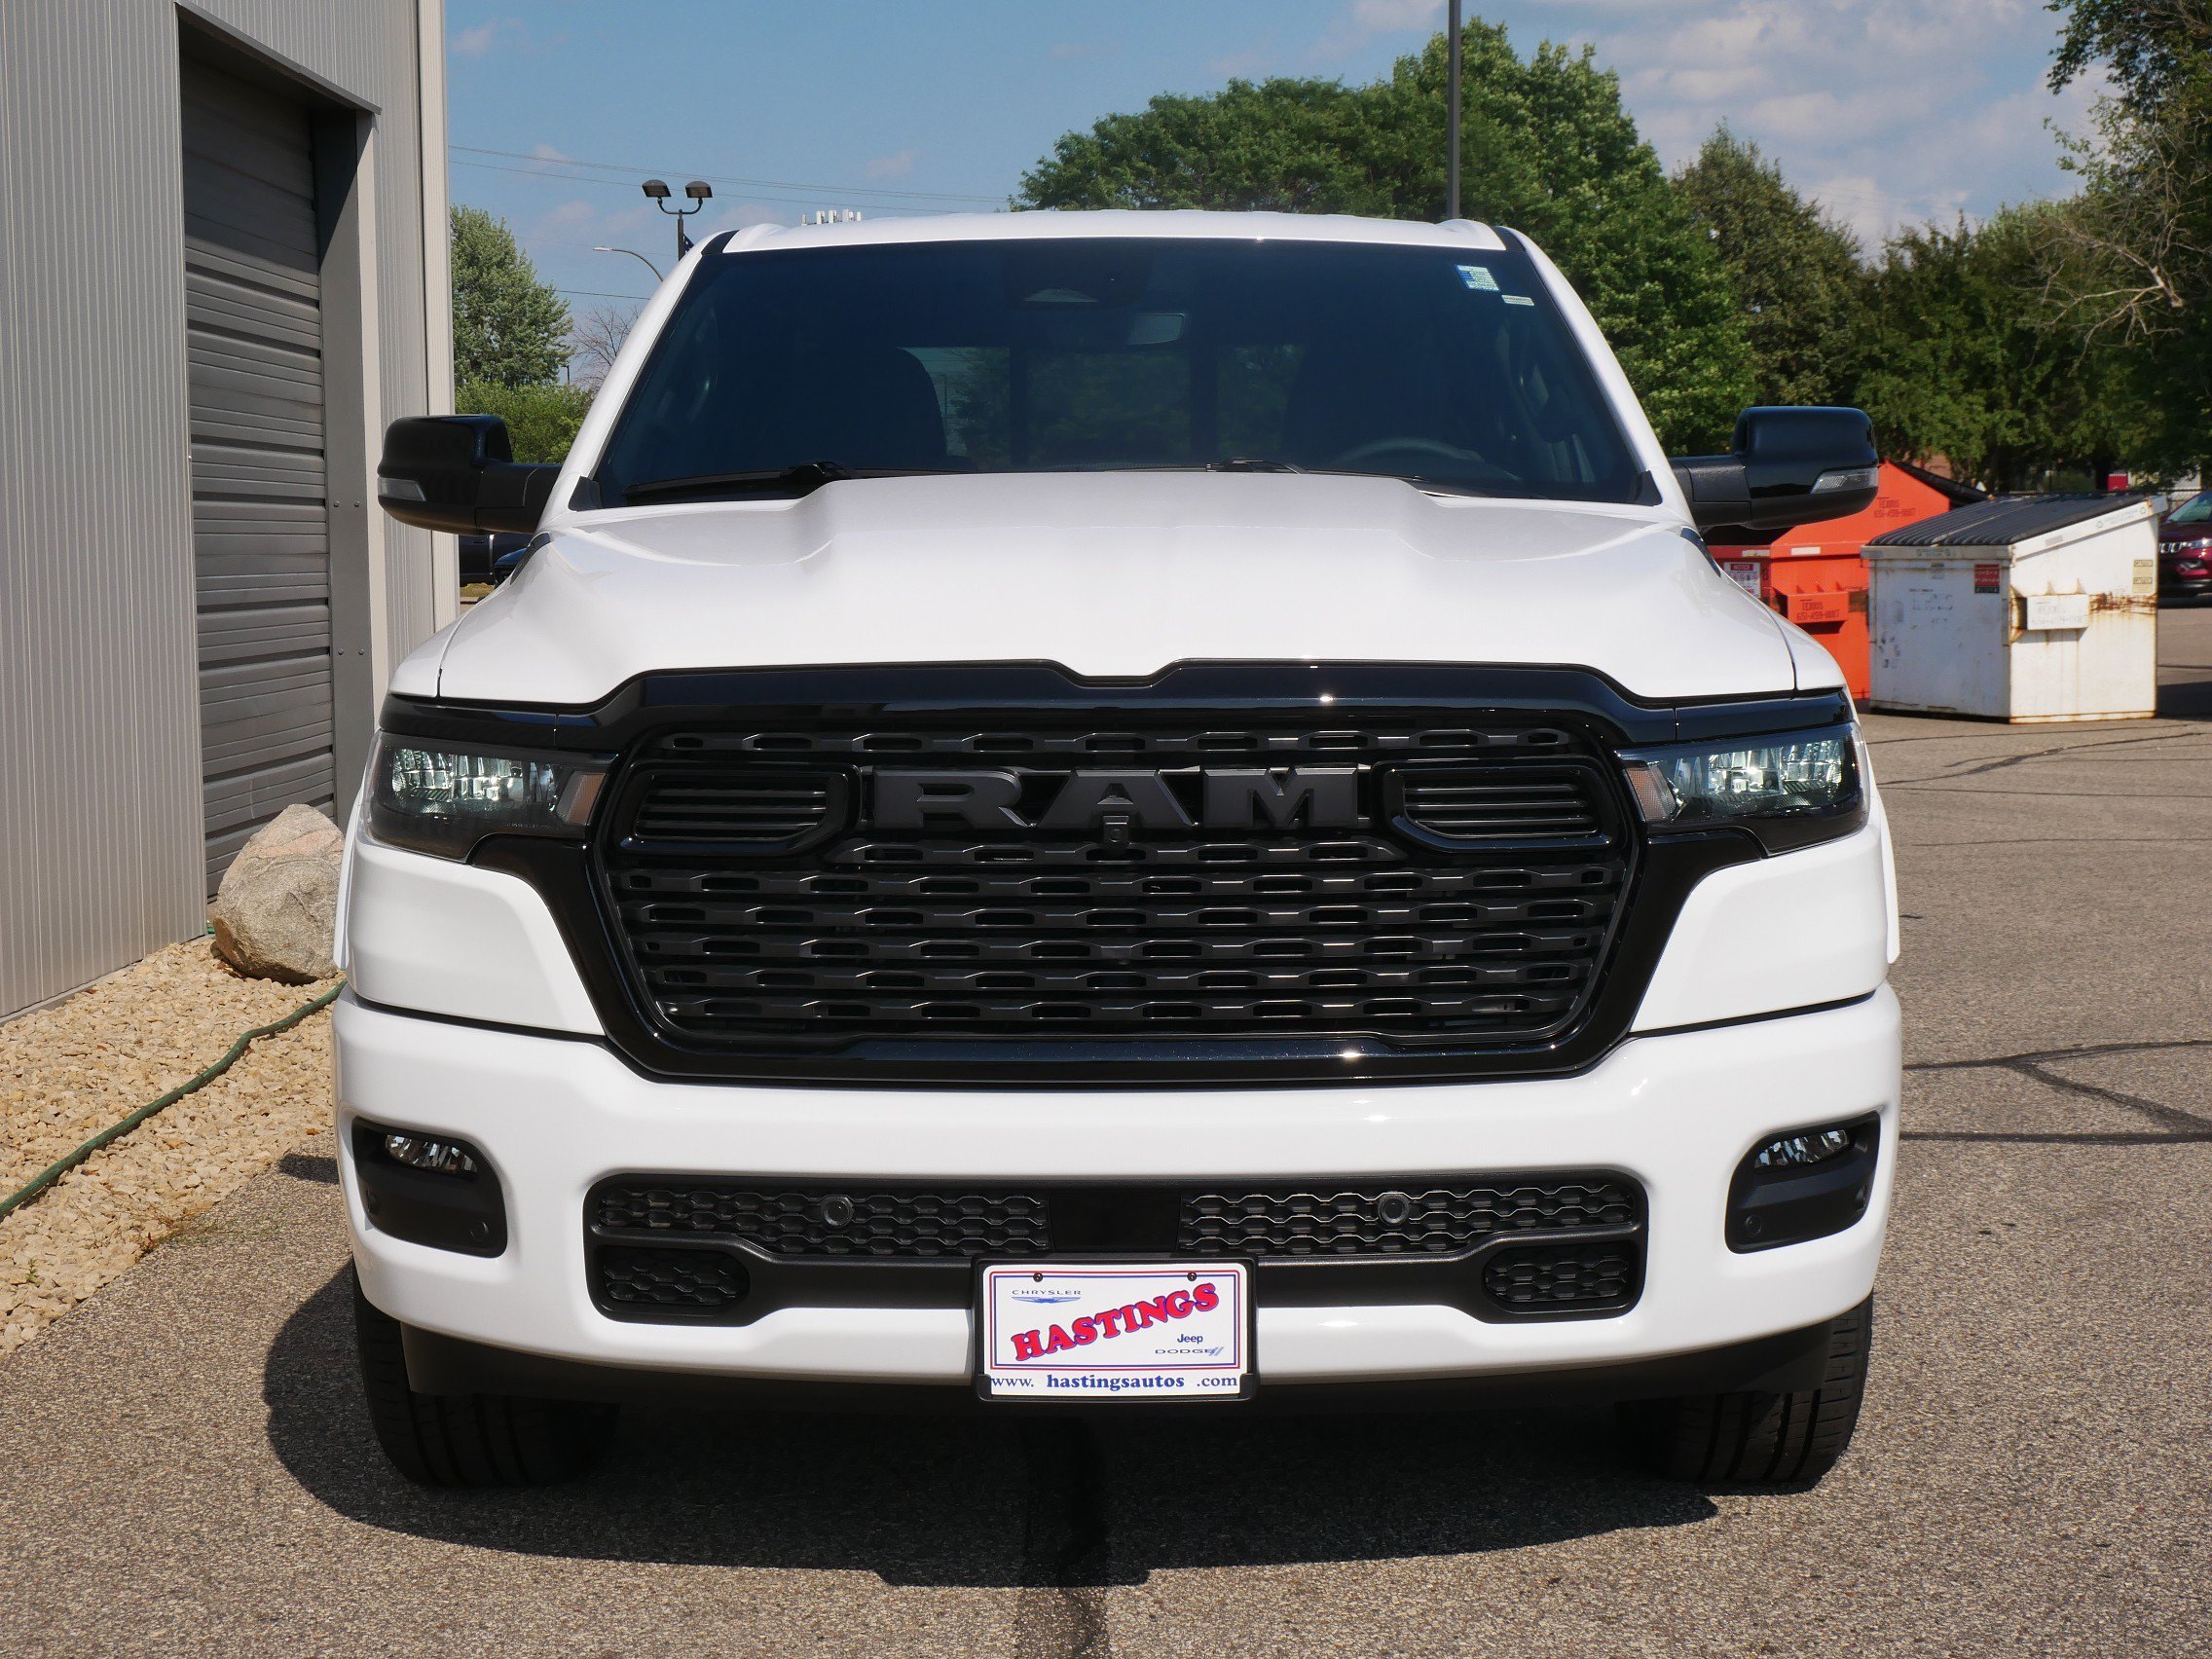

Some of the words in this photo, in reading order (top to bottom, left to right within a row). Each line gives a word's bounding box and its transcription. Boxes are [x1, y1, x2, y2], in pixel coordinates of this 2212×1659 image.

[875, 766, 1359, 829] RAM
[1010, 1282, 1220, 1362] HASTINGS
[1177, 1333, 1204, 1345] Jeep
[990, 1378, 1035, 1387] www.
[1047, 1374, 1185, 1391] hastingsautos
[1197, 1376, 1238, 1387] .com
